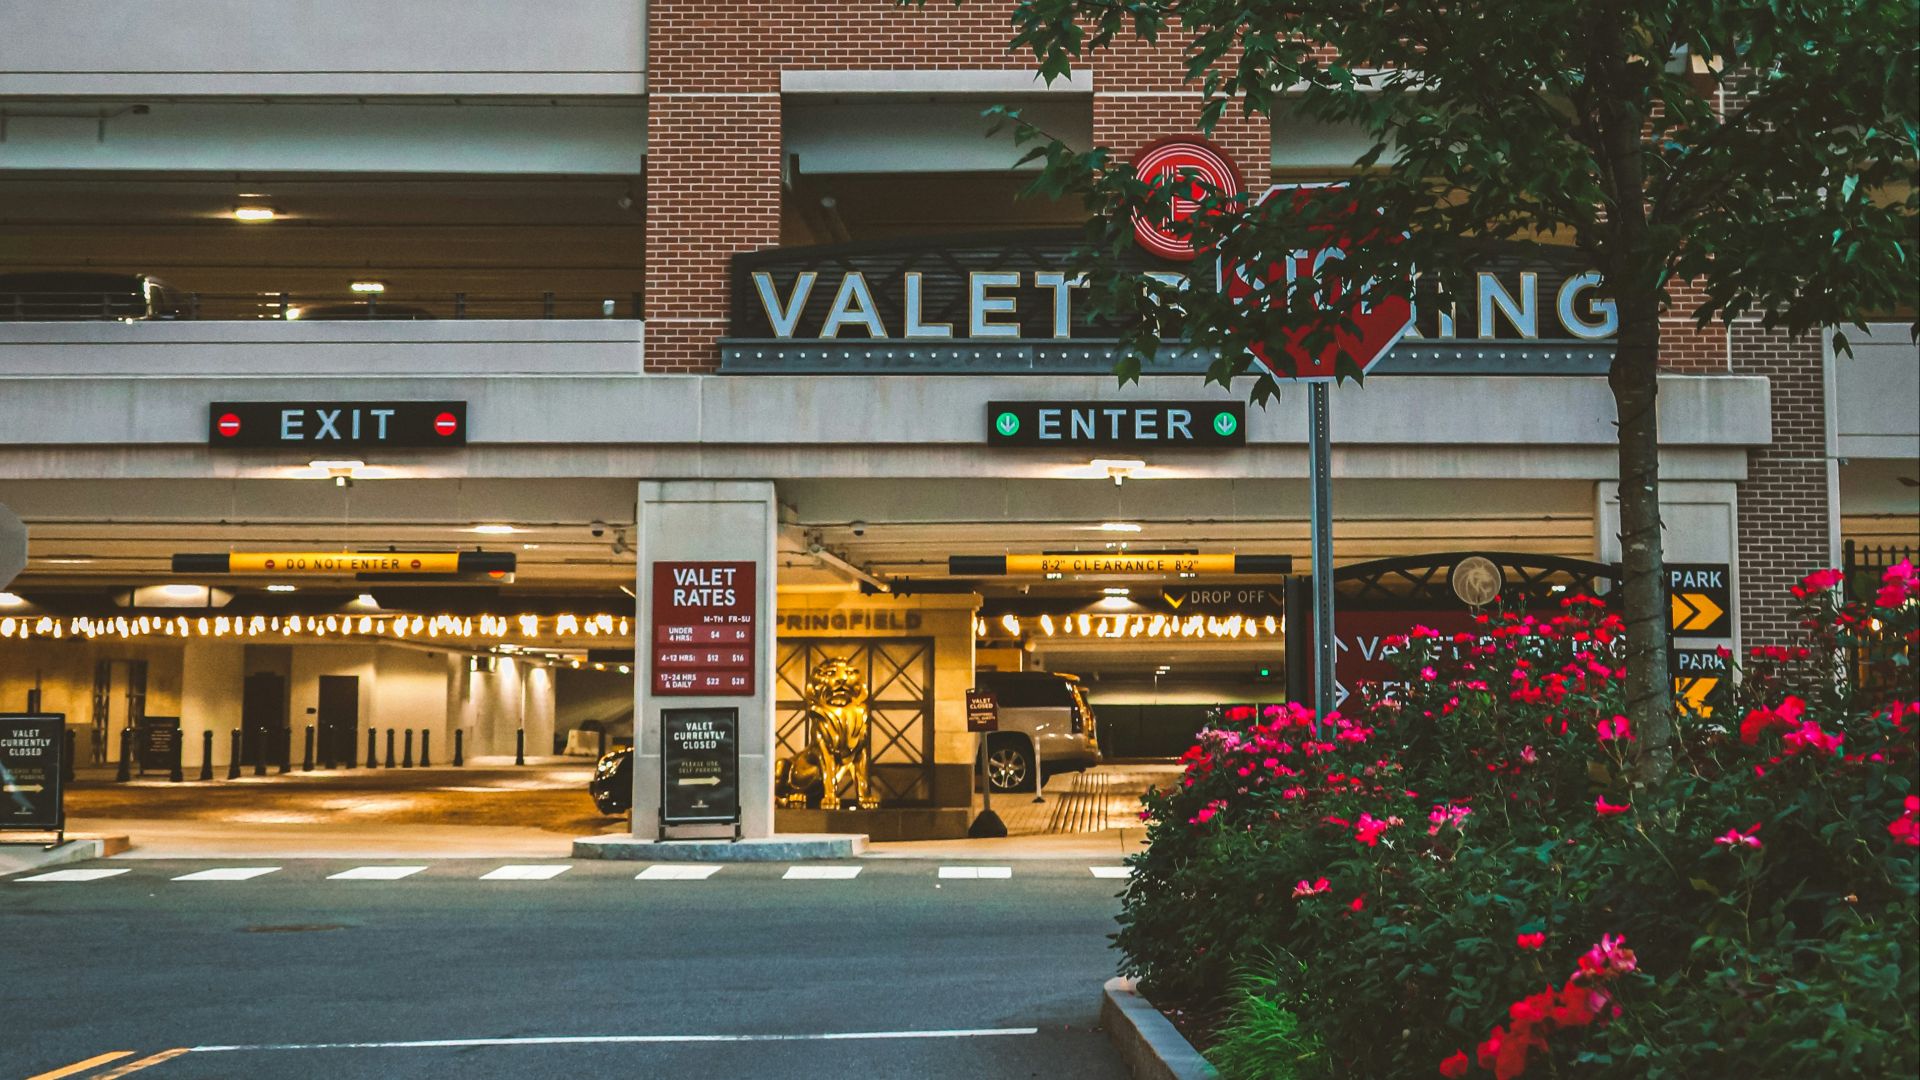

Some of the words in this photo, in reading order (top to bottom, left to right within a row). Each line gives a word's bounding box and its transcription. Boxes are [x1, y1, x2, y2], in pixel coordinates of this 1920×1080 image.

[751, 271, 1091, 338] VALET
[1143, 271, 1619, 338] PING
[281, 409, 395, 439] EXIT
[1038, 409, 1193, 439] ENTER
[286, 559, 306, 570] DO
[314, 559, 343, 570] NOT
[351, 559, 400, 570] ENTER
[1042, 560, 1066, 571] 8'-2"
[1073, 560, 1165, 571] CLEARANCE
[1175, 560, 1199, 571] 8'-2"
[673, 568, 736, 586] VALET
[1671, 570, 1723, 588] PARK
[673, 588, 736, 607] RATES
[1191, 590, 1232, 604] DROP
[1238, 590, 1265, 604] OFF
[776, 608, 922, 631] PRINGFIELD
[710, 631, 720, 639] $4
[1356, 635, 1460, 661] VAET
[1679, 653, 1726, 670] PARK
[686, 721, 713, 731] VALET
[12, 729, 39, 738] VALET
[673, 731, 726, 741] CURRENTLY
[0, 739, 51, 748] CURRENTLY
[682, 740, 717, 750] CLOSED
[9, 748, 43, 757] CLOSED
